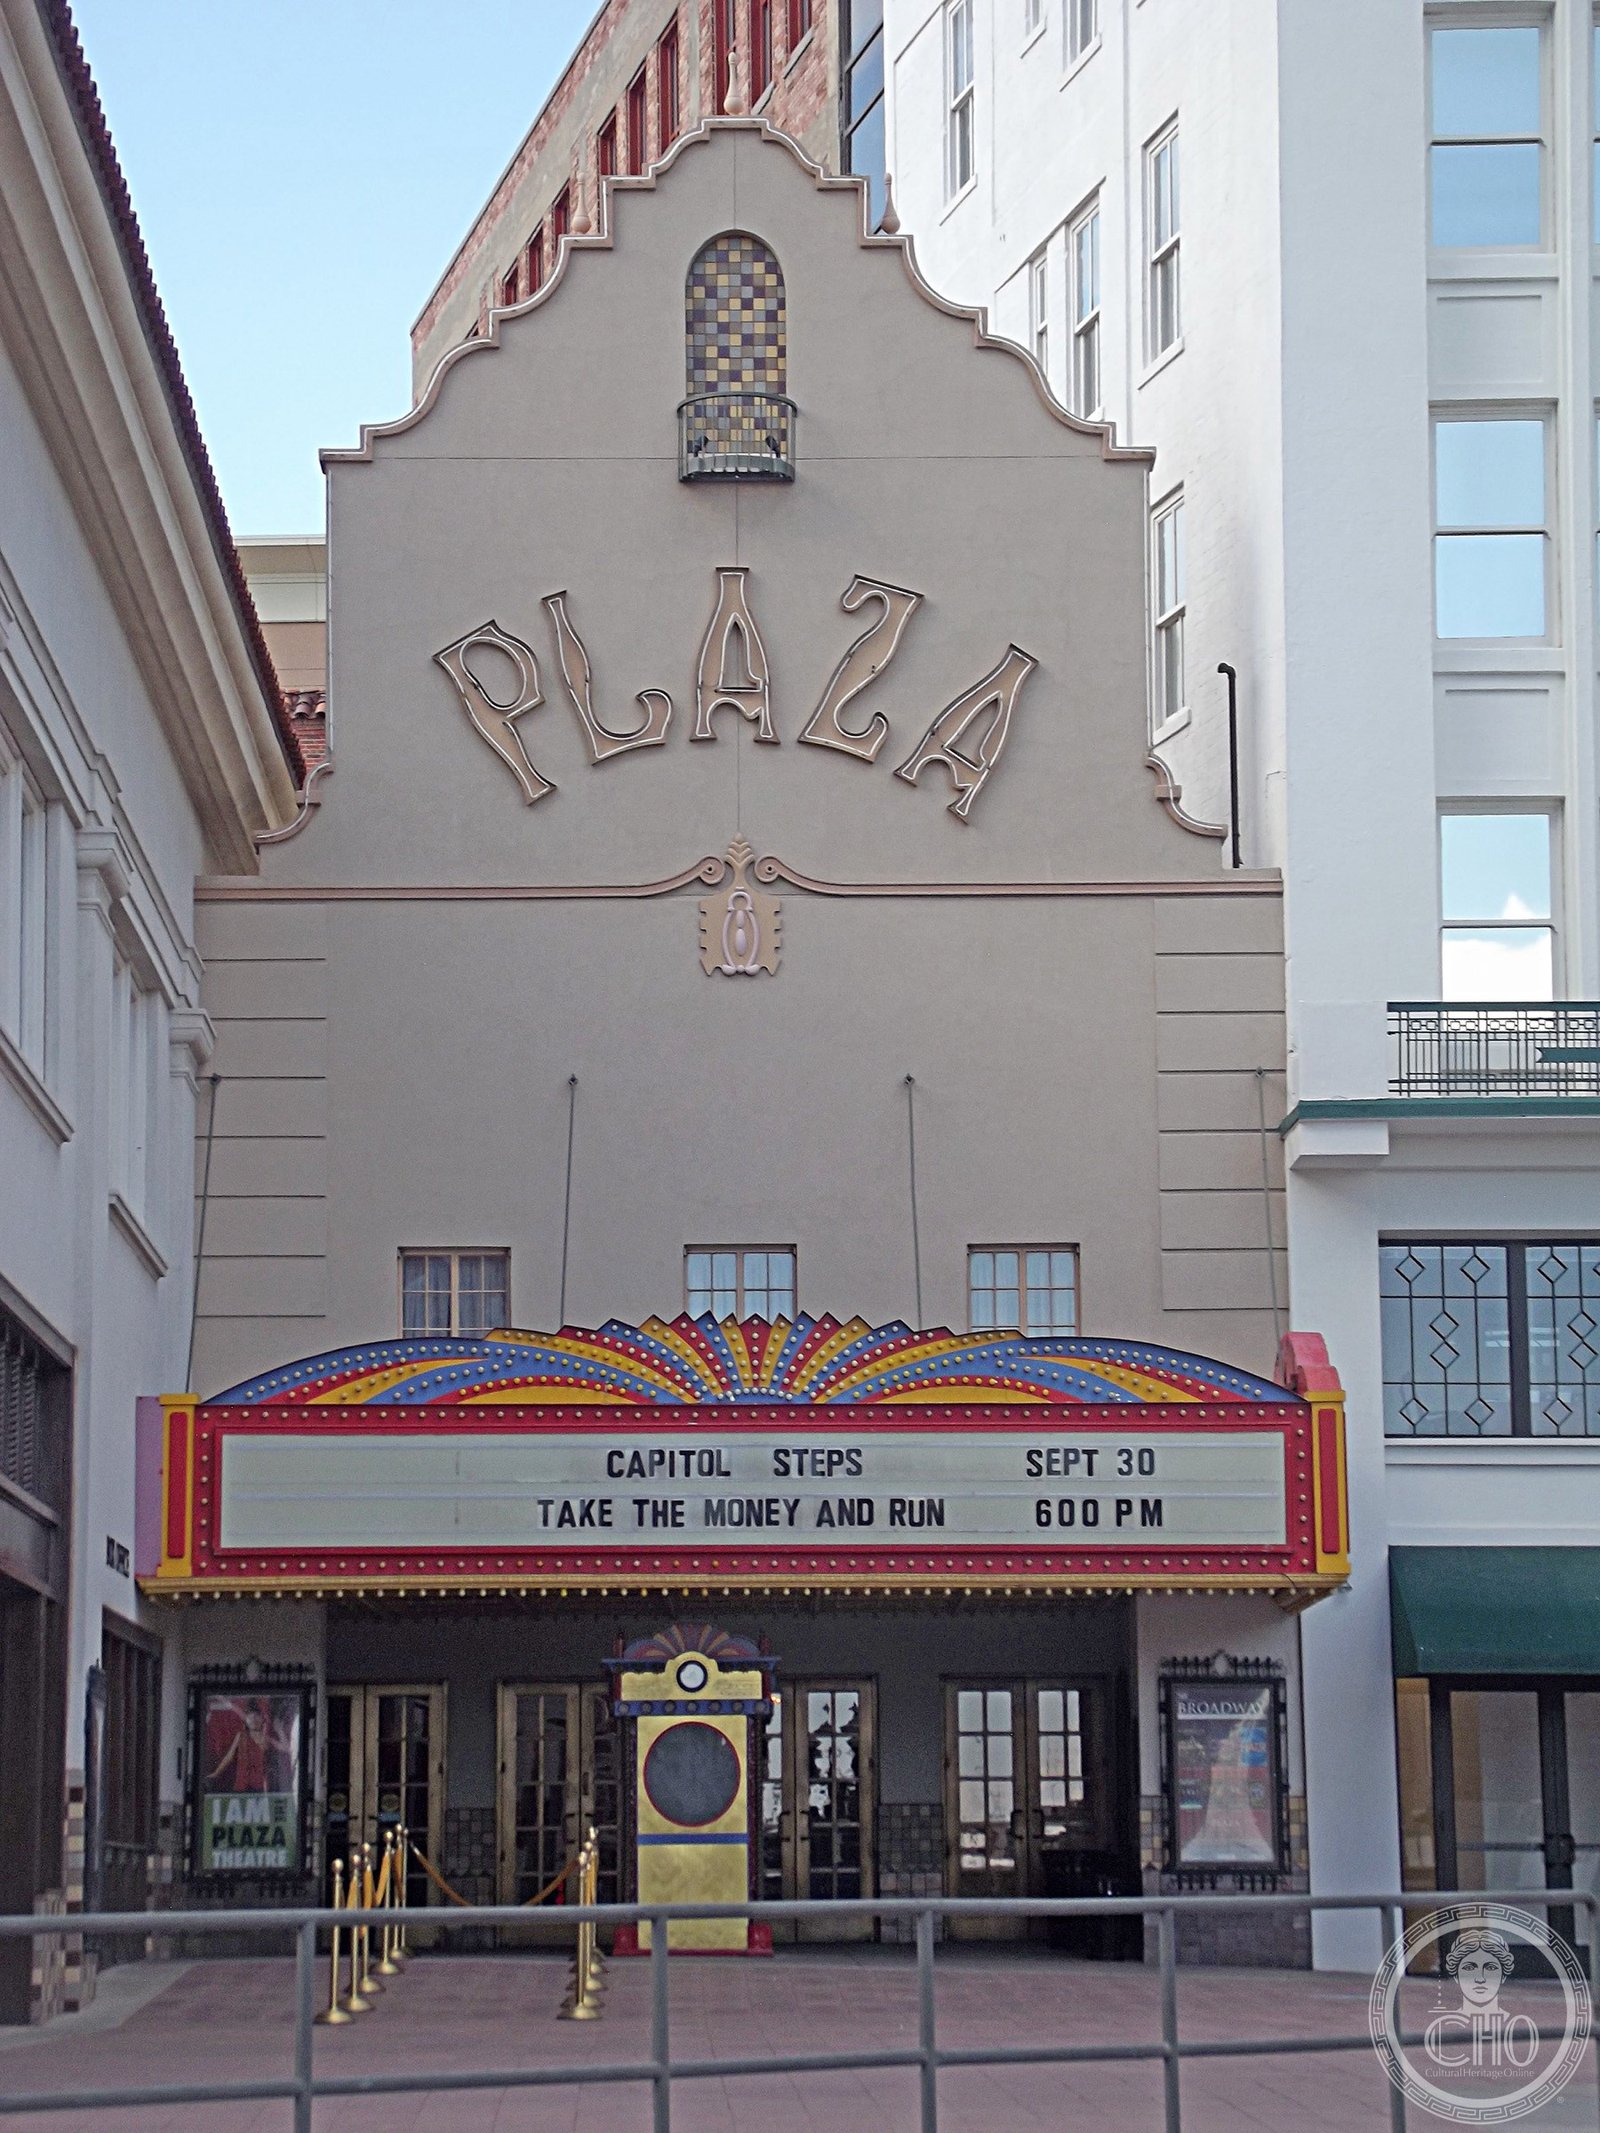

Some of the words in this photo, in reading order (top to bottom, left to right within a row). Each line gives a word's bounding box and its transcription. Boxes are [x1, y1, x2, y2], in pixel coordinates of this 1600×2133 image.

[432, 566, 1039, 824] PLAZA
[606, 1448, 732, 1479] CAPITOL
[773, 1447, 863, 1478] STEPS
[1026, 1447, 1099, 1478] SEPT
[1117, 1447, 1155, 1477] 30
[537, 1498, 613, 1529] TAKE
[632, 1498, 685, 1529] THE
[704, 1497, 800, 1528] MONEY
[815, 1497, 875, 1528] AND
[889, 1497, 945, 1528] RUN
[1035, 1498, 1100, 1528] 600
[1178, 1701, 1268, 1715] BROADWAY
[212, 1799, 221, 1825] I
[225, 1799, 270, 1825] AM
[212, 1826, 286, 1848] PLAZA
[213, 1849, 287, 1868] THEATRE
